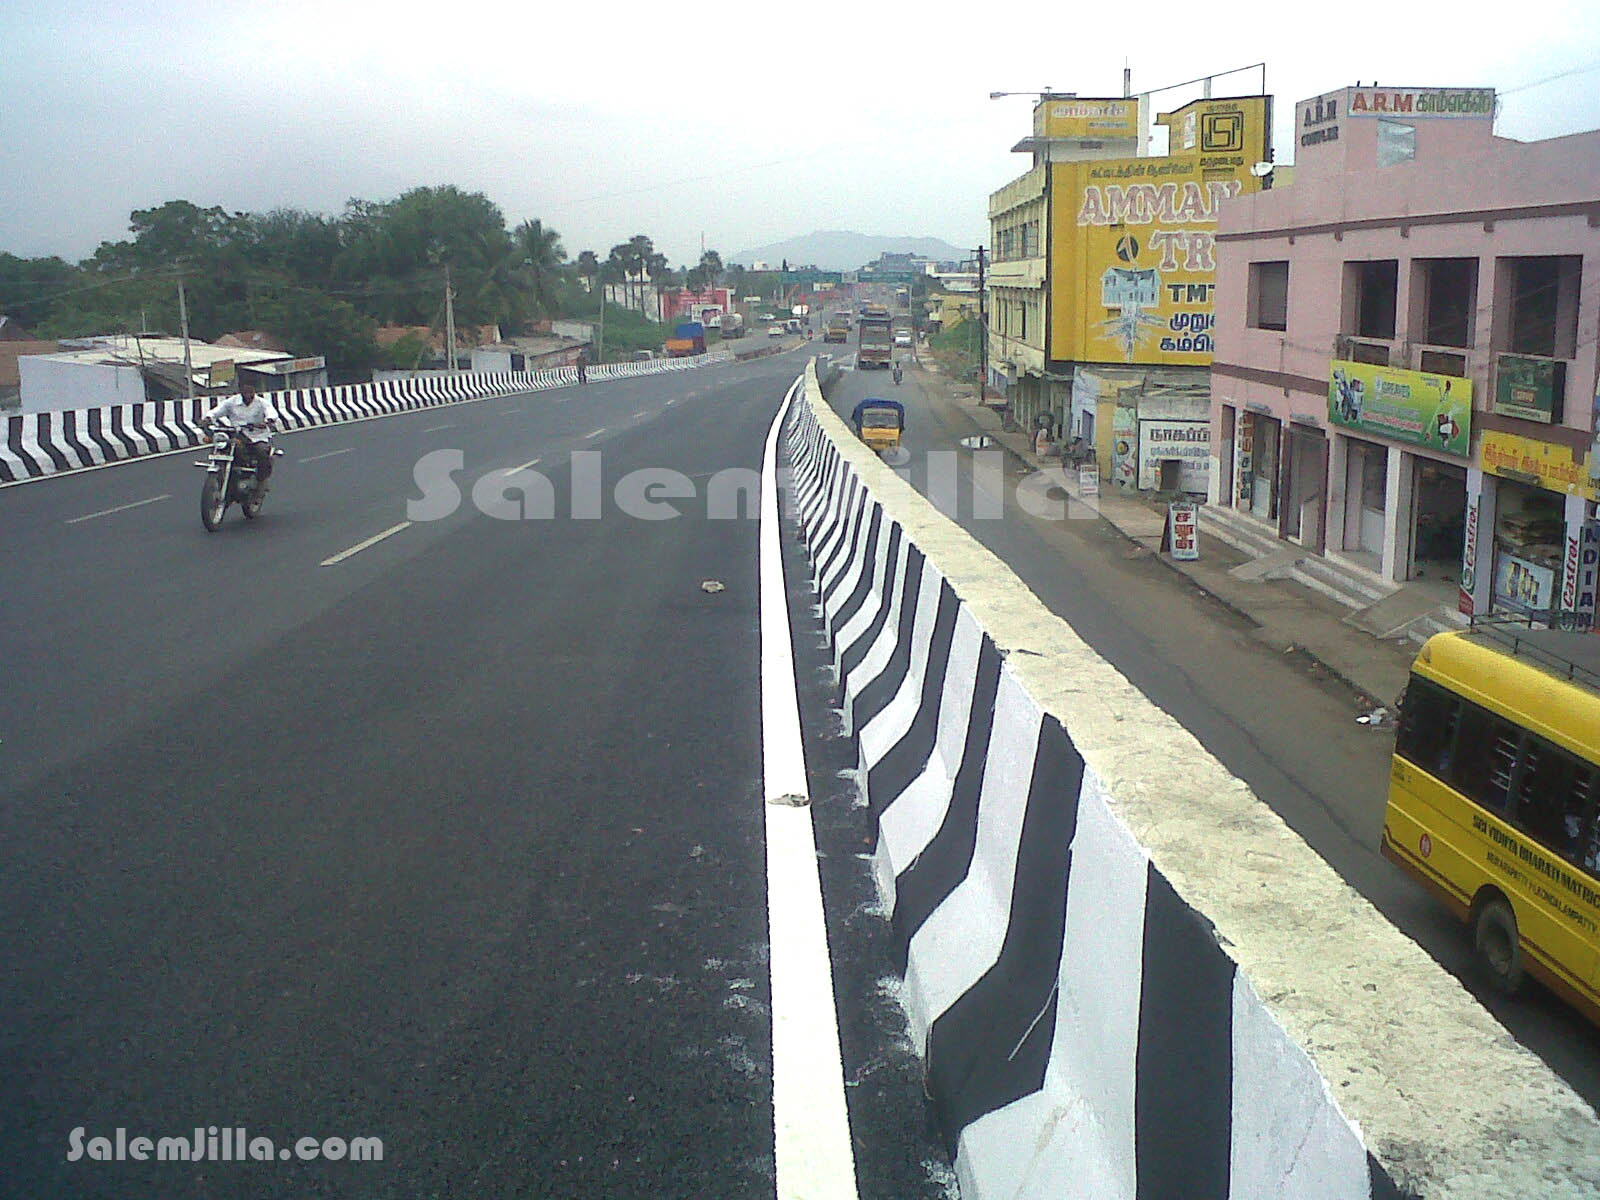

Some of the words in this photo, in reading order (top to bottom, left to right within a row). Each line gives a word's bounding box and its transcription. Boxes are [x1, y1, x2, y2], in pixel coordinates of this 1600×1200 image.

[1078, 180, 1241, 225] AMMAN
[1149, 230, 1216, 272] TR
[1160, 331, 1215, 353] கம்பி
[1466, 505, 1477, 567] Castrol
[1563, 536, 1578, 609] Castrol
